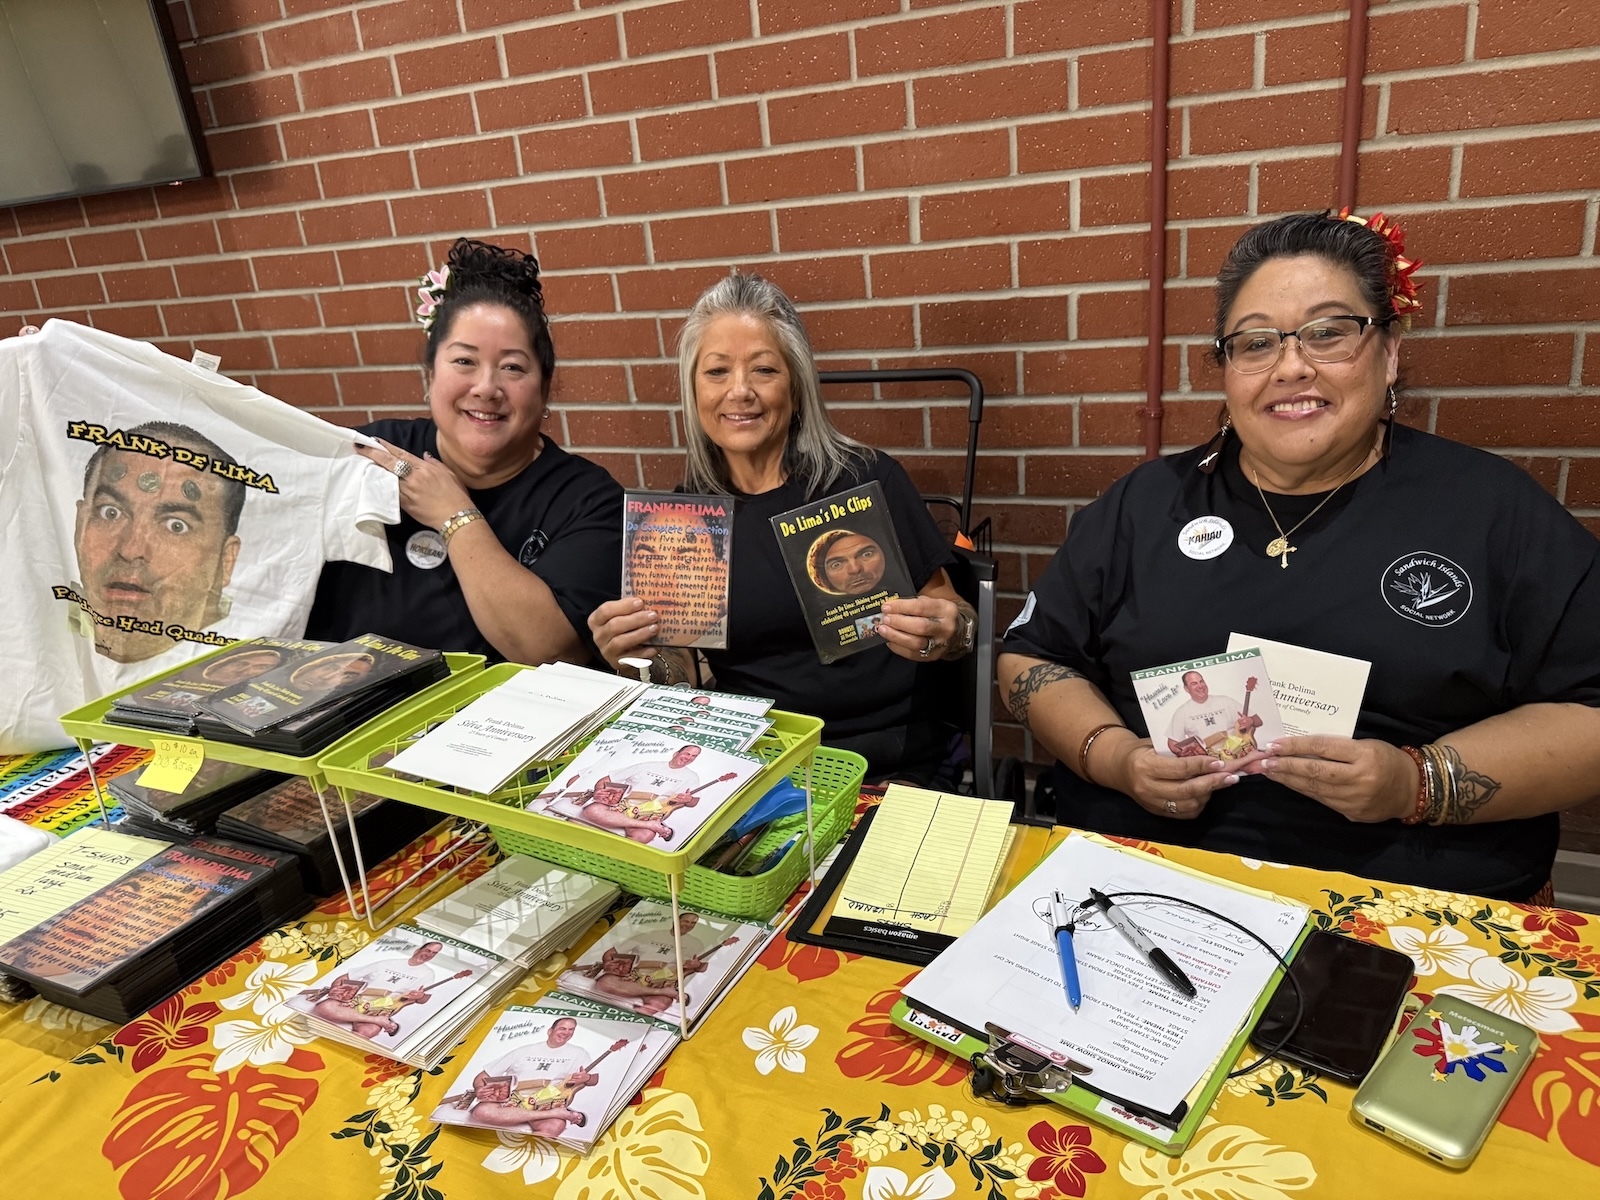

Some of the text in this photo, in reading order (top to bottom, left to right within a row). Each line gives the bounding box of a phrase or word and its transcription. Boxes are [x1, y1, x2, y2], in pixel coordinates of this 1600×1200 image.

[68, 421, 279, 494] FRANK DE LIMA
[627, 501, 726, 516] FRANK DELIMA
[780, 496, 872, 537] De Lima's De Clips
[641, 522, 682, 534] Complete
[685, 525, 728, 535] Collection
[1189, 530, 1222, 545] KAHIAU
[1394, 558, 1464, 589] Sandwich Islands
[676, 582, 708, 590] demented
[1400, 604, 1456, 620] SOCIAL NETWORK
[116, 616, 163, 636] Head
[682, 618, 698, 626] Cook
[1136, 652, 1256, 680] FRANK DELIMA
[1268, 678, 1316, 695] rank Delima
[712, 692, 768, 704] DELIMA
[1273, 689, 1340, 715] Anniversary
[645, 703, 752, 728] FRANK DELIMA
[661, 697, 767, 722] FRANK DELIMA
[1289, 705, 1311, 715] Comedy
[632, 712, 744, 737] FRANK DELIMA
[482, 722, 536, 743] Anniversary
[651, 727, 760, 763] FRANK DELIMA
[69, 846, 134, 865] T-SHIRTS
[45, 869, 94, 882] medium
[204, 863, 253, 881] DELIMA
[34, 876, 66, 889] large
[510, 886, 564, 912] Anniversary
[910, 912, 938, 921] CASH
[863, 926, 919, 940] amazon basics
[1013, 932, 1029, 941] RIGHT
[398, 923, 500, 960] FRANK DELIMA
[1030, 940, 1047, 949] STAGE
[1198, 948, 1221, 959] Kamaka
[1214, 942, 1244, 956] MAHALOS
[1086, 951, 1104, 960] FRANK
[1105, 959, 1124, 969] UNCLE
[1178, 958, 1194, 966] Frank
[1192, 957, 1216, 969] Curtains
[1015, 963, 1039, 976] CHASING
[1088, 964, 1106, 973] FROM
[1113, 968, 1131, 978] STAGE
[1124, 967, 1143, 976] INTRO
[1106, 972, 1126, 982] WALKS
[1190, 975, 1220, 988] CURTAINS
[1145, 981, 1170, 994] KAMAKA
[1197, 984, 1217, 993] ALLAN
[548, 992, 604, 1011] FRANK
[1082, 993, 1100, 1003] FROM
[1101, 1001, 1121, 1012] WALKS
[1154, 1004, 1180, 1016] KAMAKA
[1189, 1005, 1203, 1013] 2:25
[510, 1005, 646, 1024] FRANK DELIMA
[1182, 1015, 1196, 1023] 2:05
[1108, 1018, 1129, 1029] SHOW
[1116, 1014, 1180, 1044] (Intro Uncle Kamaka)
[1168, 1023, 1188, 1034] STAGE
[508, 1031, 529, 1040] Love
[1129, 1028, 1149, 1038] START
[1166, 1029, 1179, 1037] REX
[1060, 1039, 1074, 1048] TIME
[1112, 1041, 1129, 1050] Open
[1122, 1038, 1168, 1060] Ambient music
[1161, 1041, 1176, 1050] 2:00
[1075, 1047, 1096, 1058] SHOW
[1086, 1044, 1128, 1064] approximate)
[1130, 1049, 1149, 1059] Doors
[1120, 1066, 1152, 1080] JURASSIC
[1129, 1063, 1144, 1071] time
